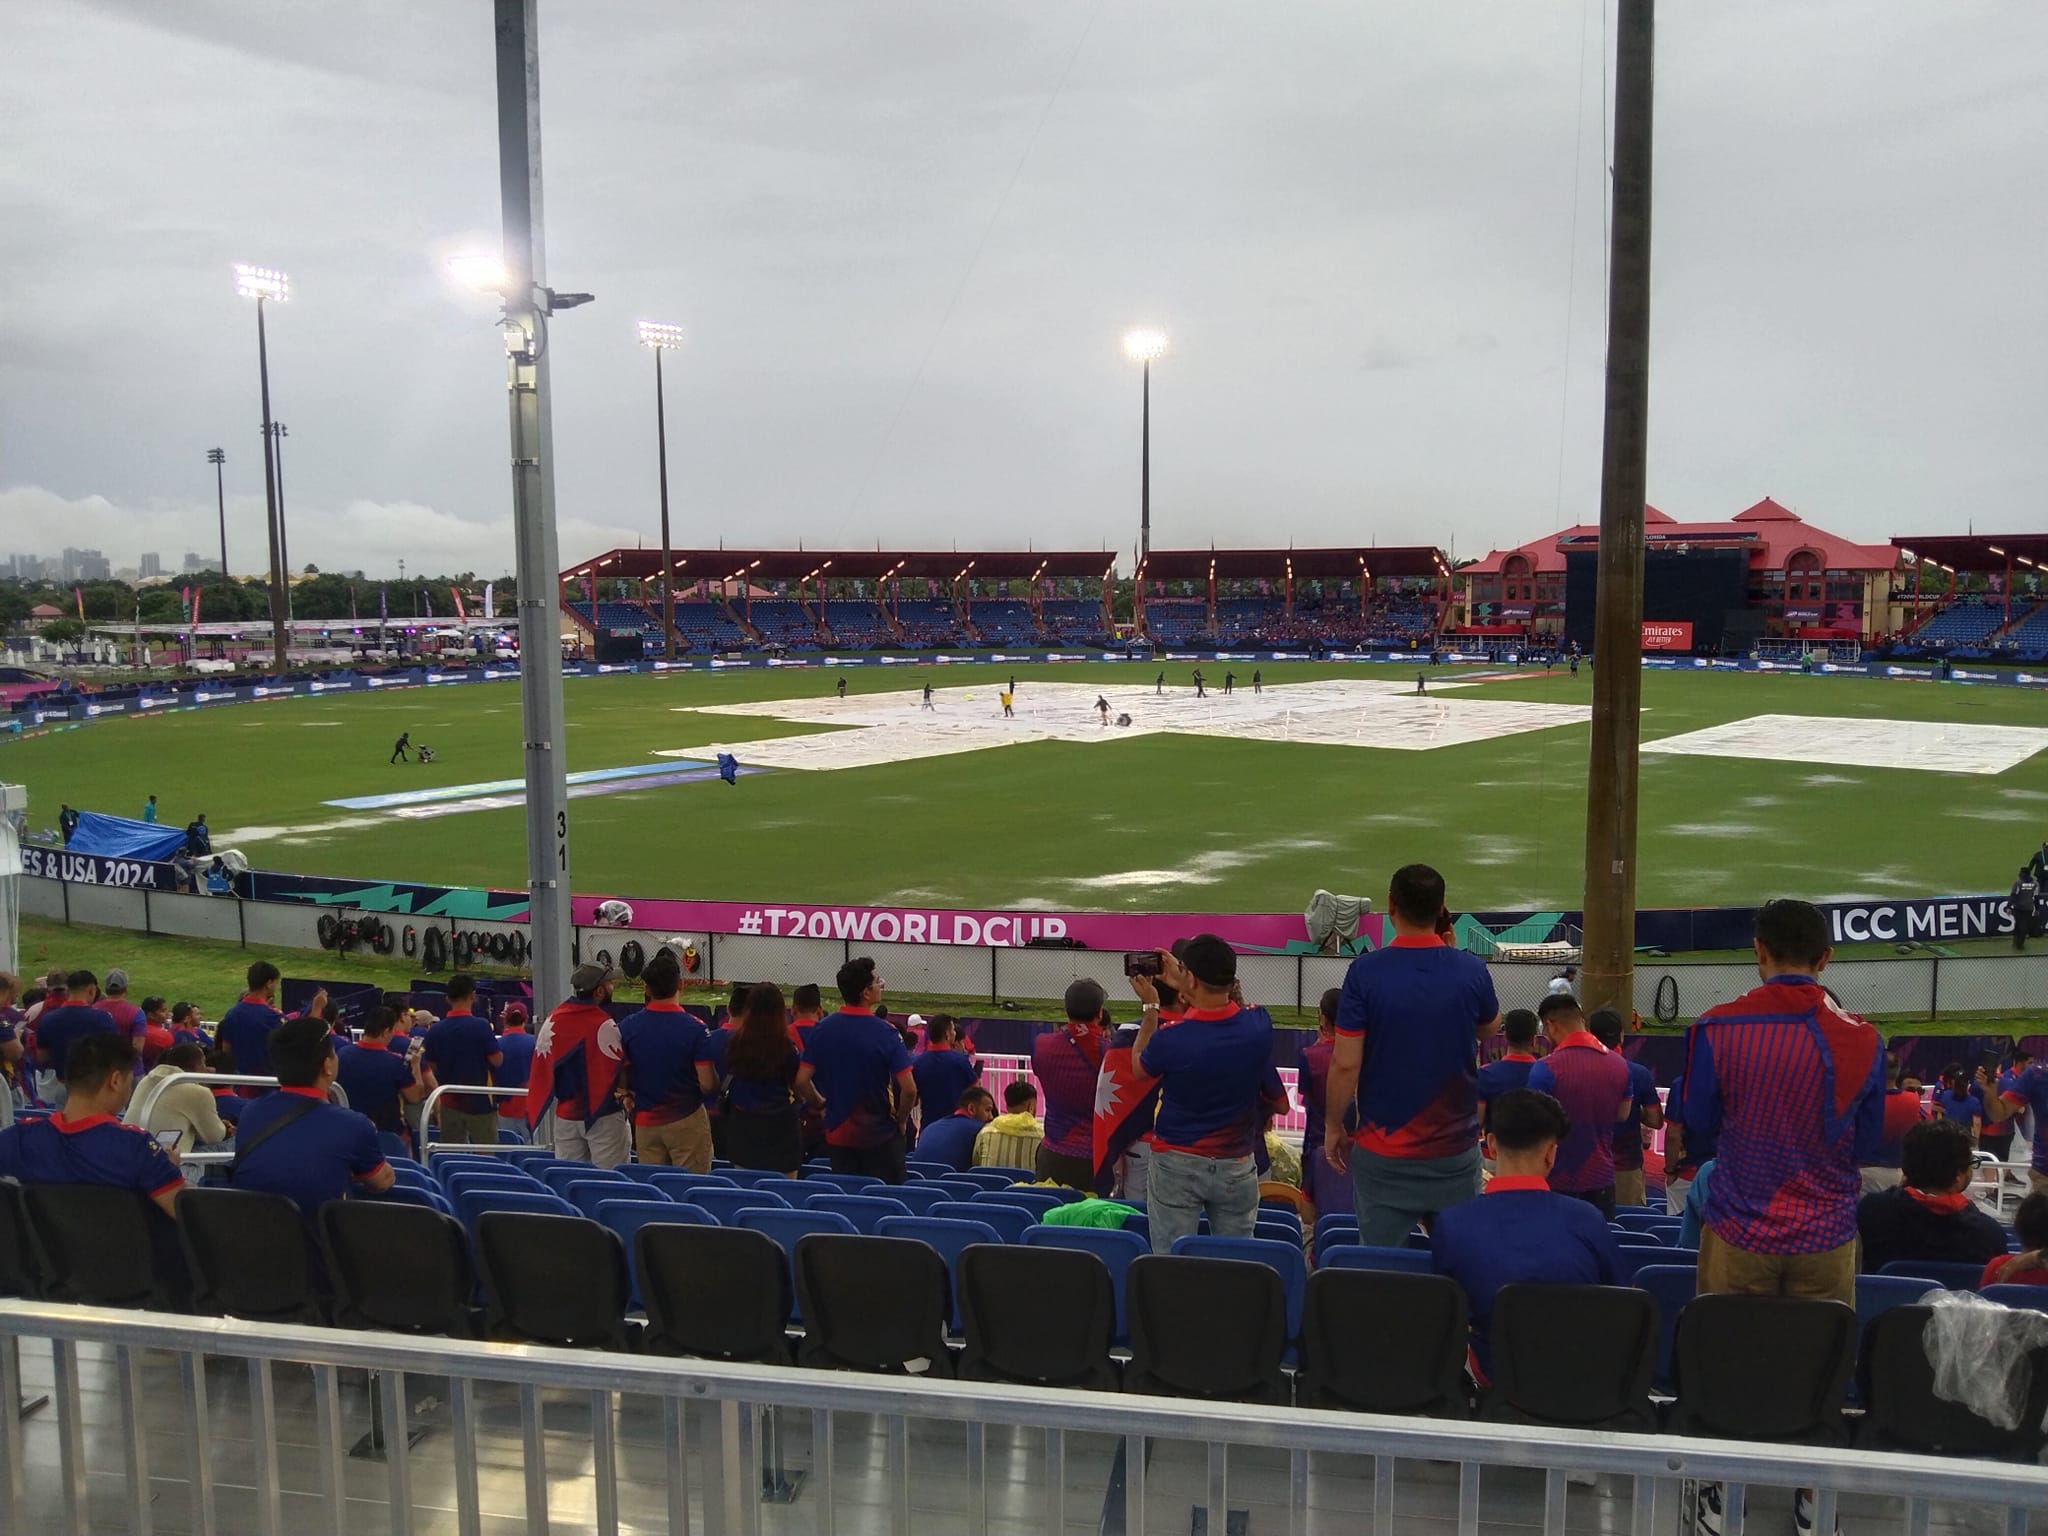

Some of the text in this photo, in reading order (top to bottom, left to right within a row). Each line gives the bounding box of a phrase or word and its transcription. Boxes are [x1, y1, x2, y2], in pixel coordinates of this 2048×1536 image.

[46, 852, 58, 879] &
[61, 855, 97, 884] USA
[103, 860, 157, 888] 2024
[737, 908, 1067, 947] #T20WORLDCUP
[1832, 900, 2016, 942] ICC MEN'S
